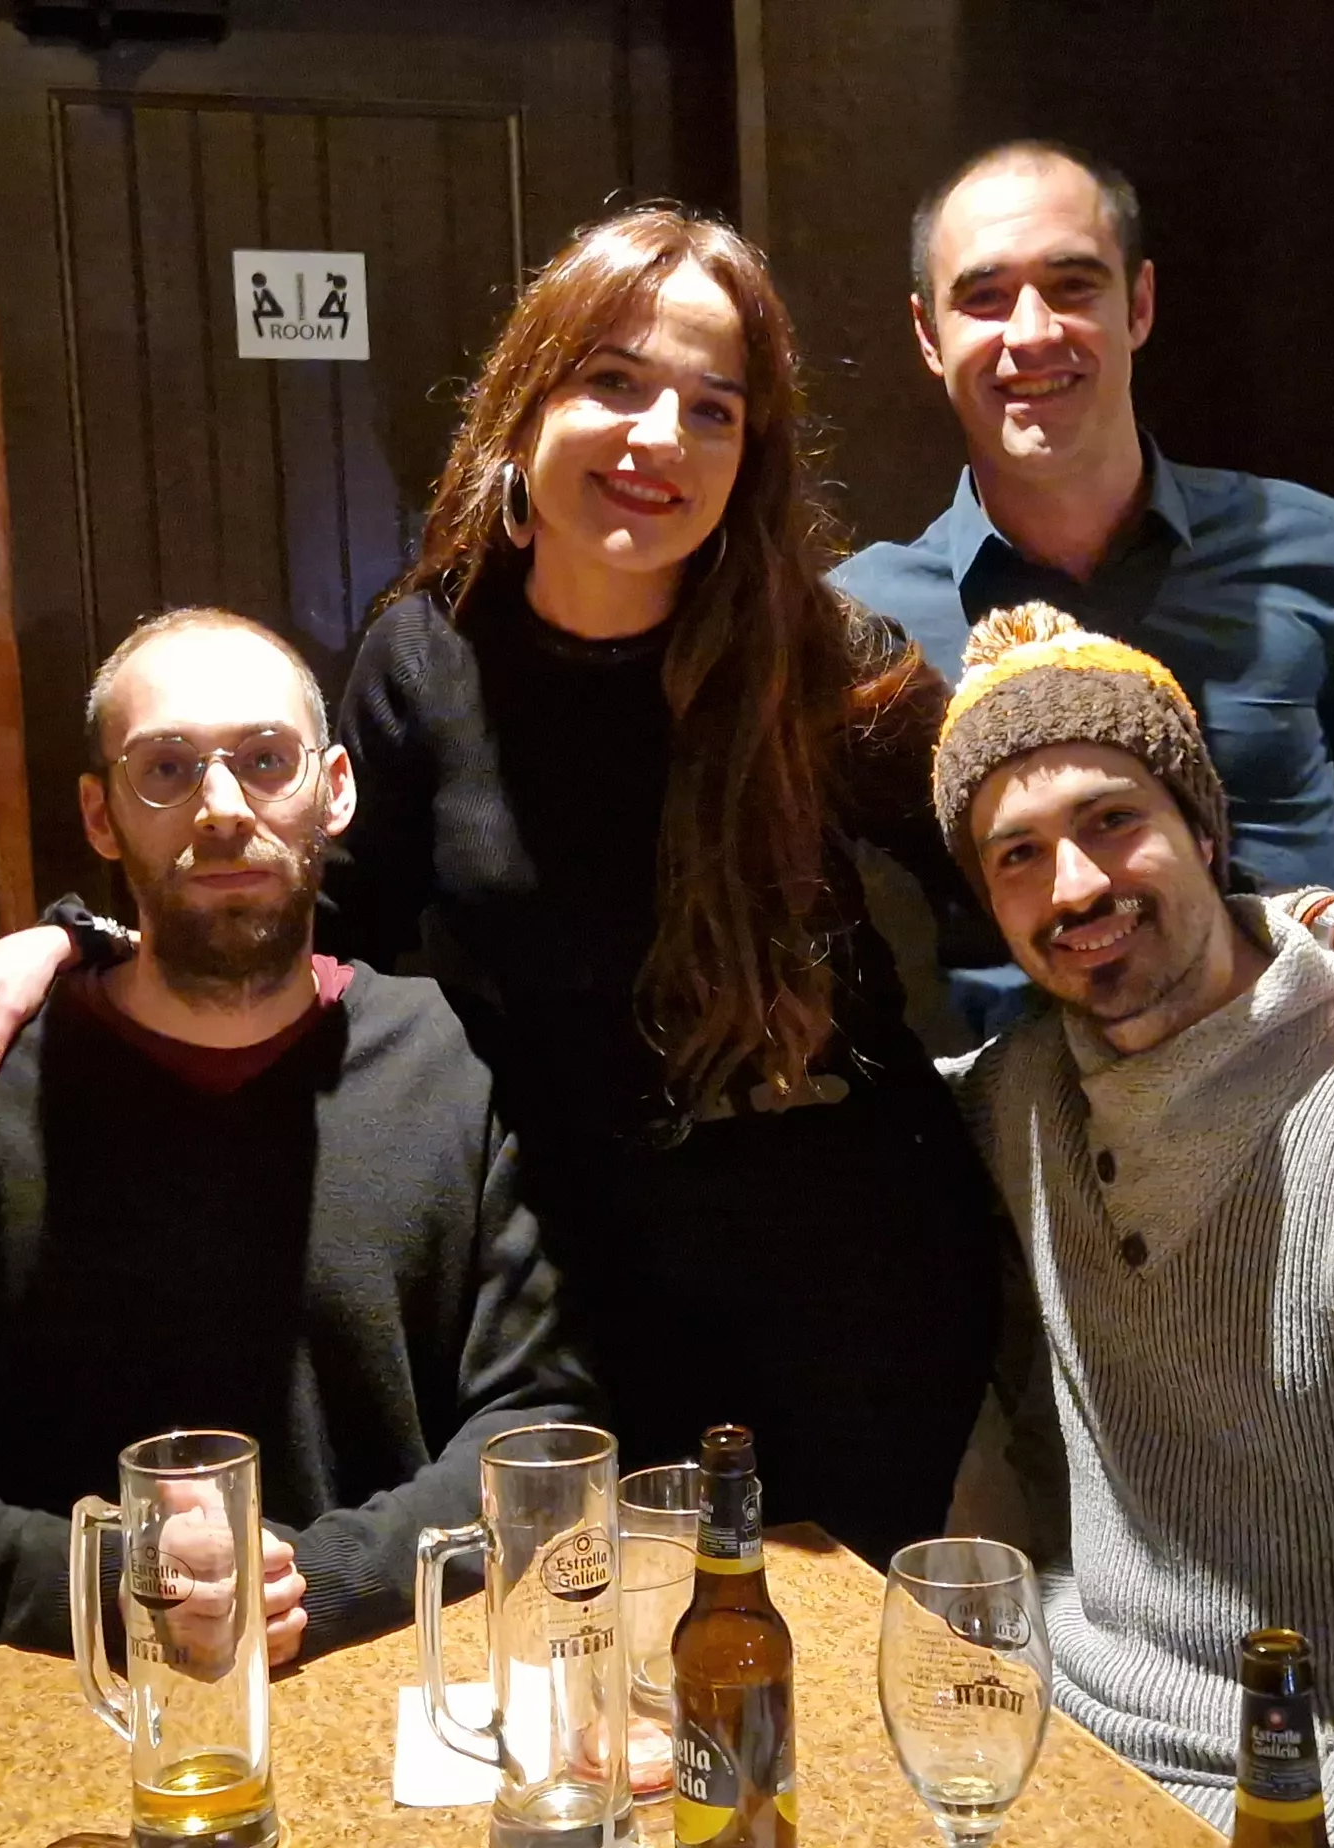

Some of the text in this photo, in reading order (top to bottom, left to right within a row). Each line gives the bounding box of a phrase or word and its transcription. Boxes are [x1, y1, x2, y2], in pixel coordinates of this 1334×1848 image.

[270, 323, 334, 340] ROOM
[555, 1550, 607, 1572] Estrella
[558, 1567, 606, 1588] Galicia
